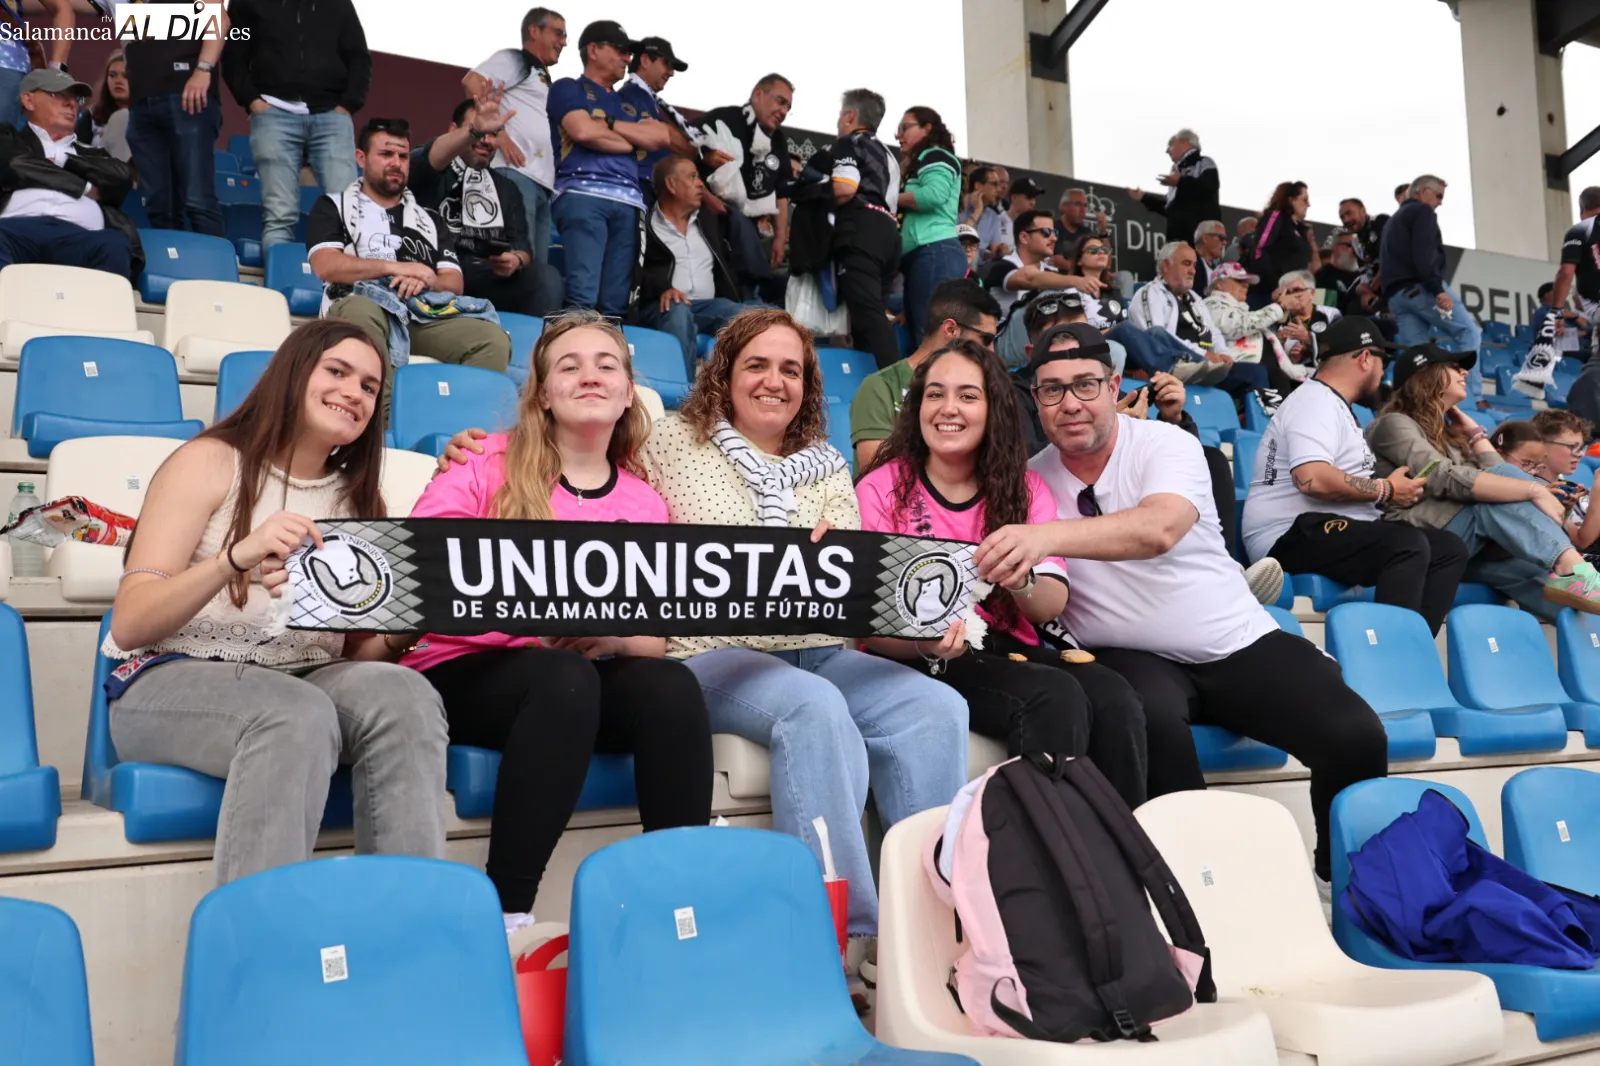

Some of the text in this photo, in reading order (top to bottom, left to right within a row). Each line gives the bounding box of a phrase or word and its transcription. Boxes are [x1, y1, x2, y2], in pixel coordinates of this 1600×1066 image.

[446, 537, 855, 599] UNIONISTAS
[453, 598, 847, 620] DE SALAMANCA CLUB DE FÚTBOL
